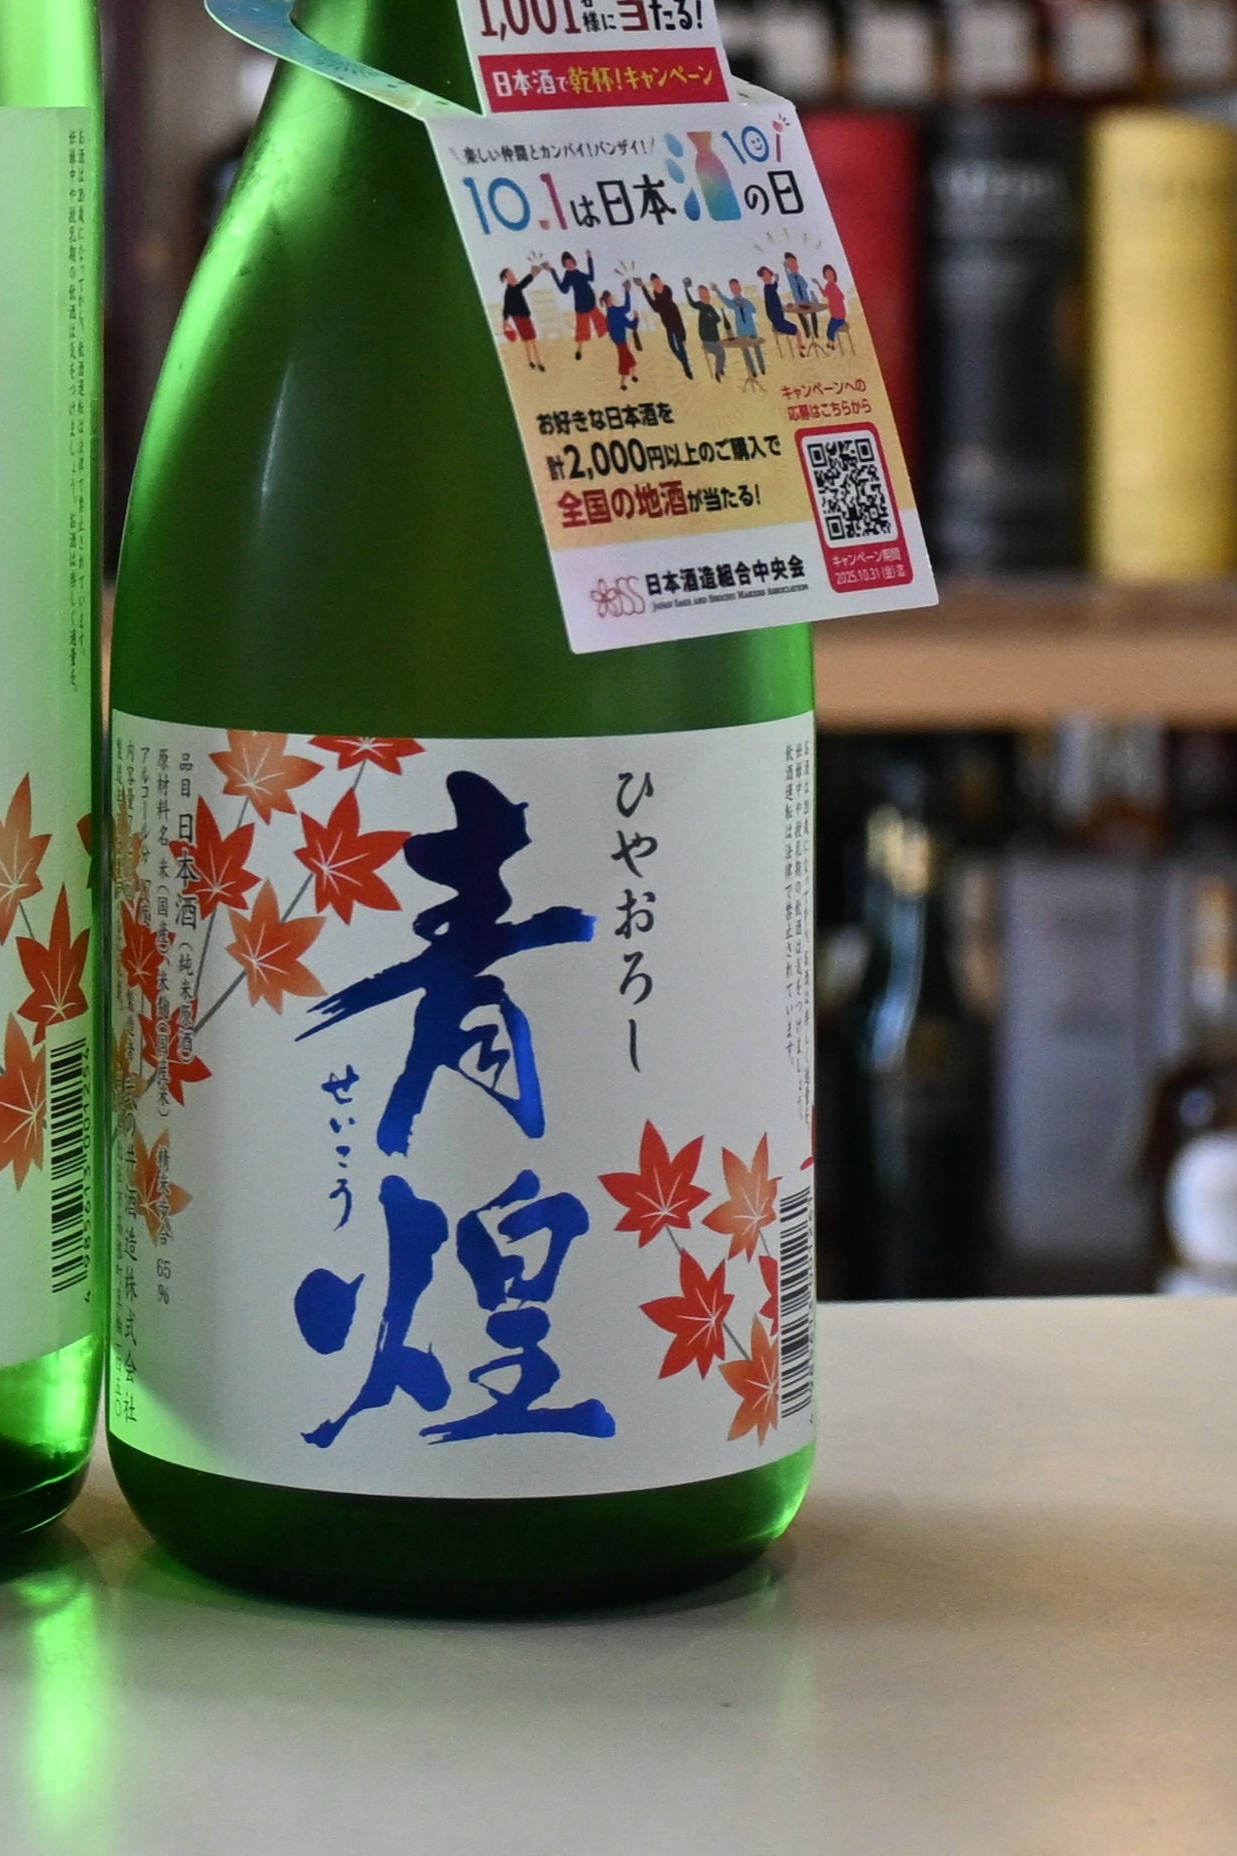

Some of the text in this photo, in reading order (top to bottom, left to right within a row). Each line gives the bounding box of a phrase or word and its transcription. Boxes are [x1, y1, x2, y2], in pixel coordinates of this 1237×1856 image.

[536, 402, 674, 435] お好きな日本酒を
[546, 435, 782, 481] 計2,000円以上のご購入で
[645, 554, 806, 597] 日本酒造組合中央会
[611, 771, 658, 1073] ひやおろし
